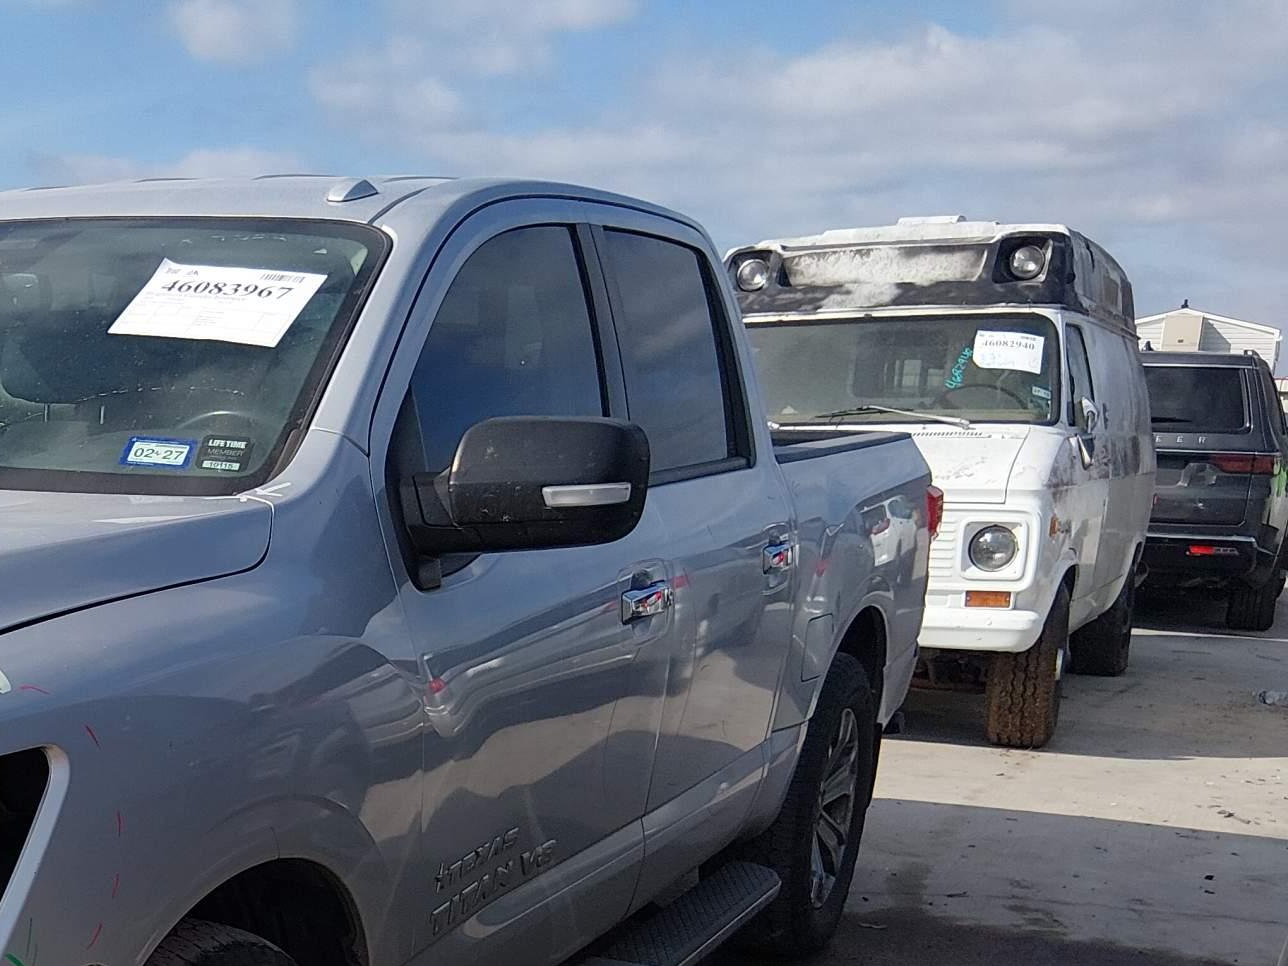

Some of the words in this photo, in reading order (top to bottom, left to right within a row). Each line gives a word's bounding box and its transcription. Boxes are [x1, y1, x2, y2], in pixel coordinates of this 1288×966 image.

[161, 279, 295, 300] 46083967
[982, 339, 1035, 350] 46082940
[207, 439, 225, 447] LIFE
[225, 440, 248, 449] TIME
[430, 859, 513, 936] TITAN
[520, 839, 557, 876] V8
